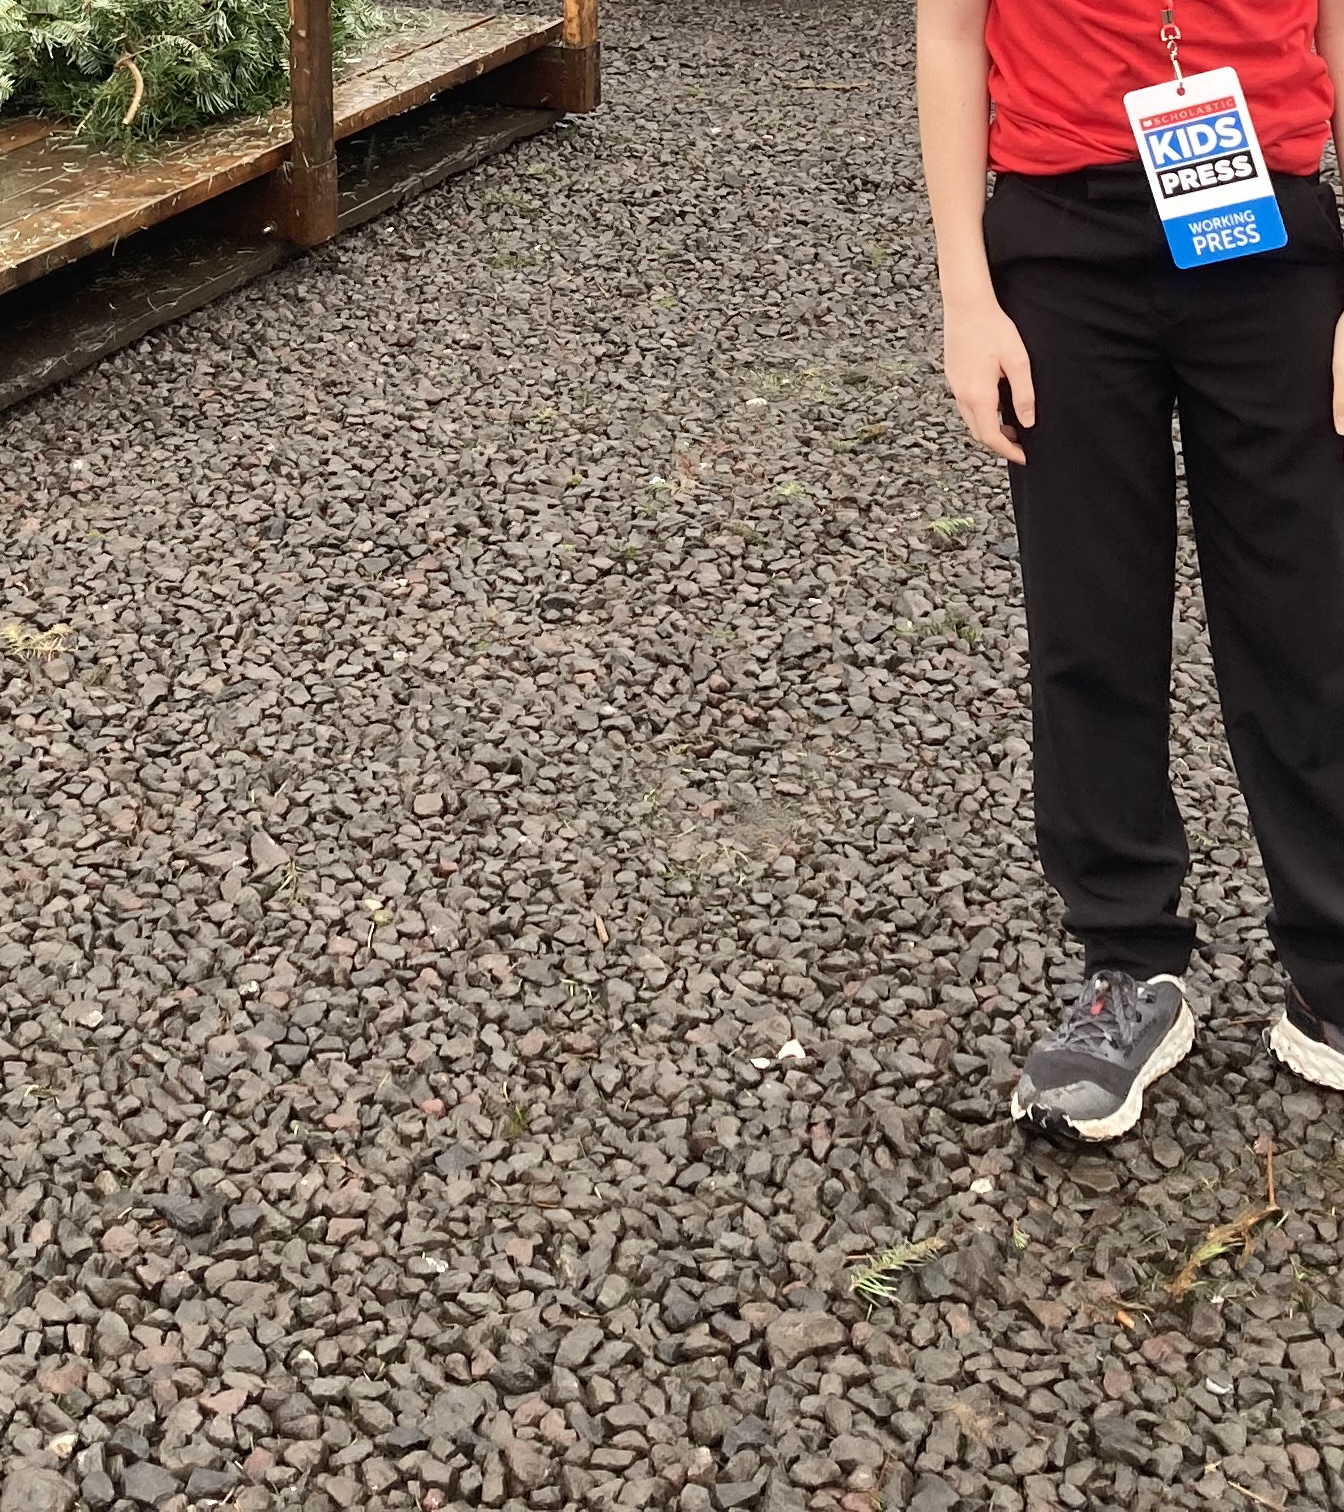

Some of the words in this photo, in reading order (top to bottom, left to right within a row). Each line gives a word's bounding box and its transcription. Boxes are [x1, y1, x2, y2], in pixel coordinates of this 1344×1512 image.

[1153, 98, 1235, 126] SCHOLASTIC
[1149, 116, 1243, 165] KIDS
[1160, 155, 1253, 196] PRESS
[1188, 210, 1256, 234] WORKING
[1192, 224, 1261, 255] PRESS
